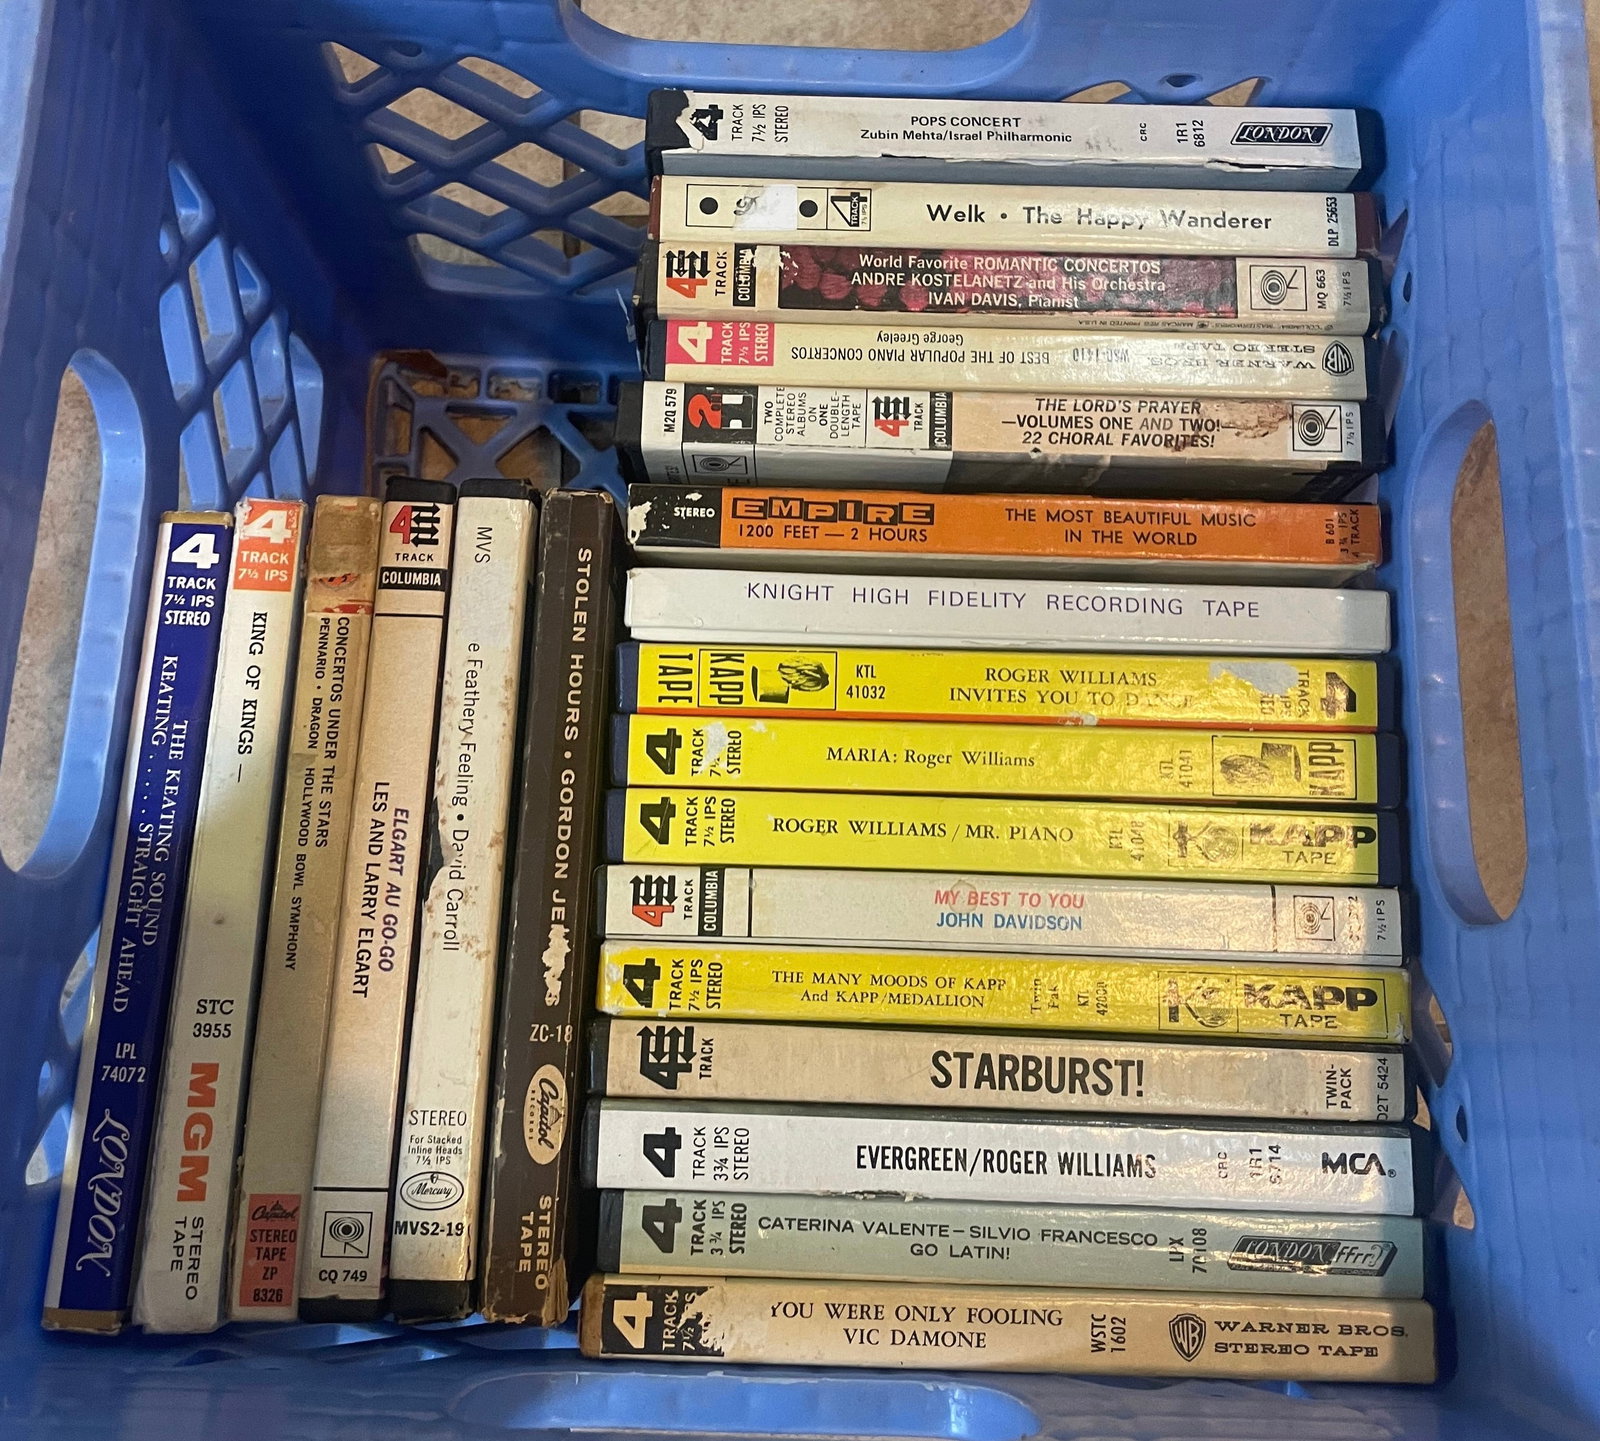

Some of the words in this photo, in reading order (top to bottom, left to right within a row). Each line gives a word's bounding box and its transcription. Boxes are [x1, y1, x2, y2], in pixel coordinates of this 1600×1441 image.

[732, 104, 743, 141] TRACK
[911, 116, 946, 126] POPS
[950, 116, 1021, 130] CONCERT
[861, 130, 898, 140] Zubin
[903, 130, 983, 141] Mehta/Israel
[987, 131, 1072, 143] Philharmonic
[928, 204, 985, 223] Welk
[1024, 206, 1062, 225] The
[1077, 208, 1147, 229] Happy
[1160, 209, 1271, 229] Wanderer
[860, 254, 902, 268] World
[909, 256, 968, 270] Favorite
[973, 257, 1058, 272] ROMANTIC
[1064, 258, 1160, 274] CONCERTOS
[851, 273, 905, 286] ANDRE
[911, 274, 1024, 290] KOSTELANETZ
[1062, 278, 1086, 290] His
[1092, 279, 1165, 292] Orchestra
[929, 293, 965, 305] IVAN
[1029, 296, 1078, 308] Pianist
[876, 331, 919, 344] Greeley
[923, 334, 964, 346] George
[791, 346, 862, 361] CONCERTOS
[868, 348, 905, 362] PIANO
[911, 349, 965, 363] POPULAR
[1020, 351, 1050, 365] BEST
[764, 401, 773, 424] TWO
[775, 387, 785, 442] COMPLETE
[797, 391, 806, 437] ALBUMS
[841, 394, 850, 437] LENGTH
[1036, 398, 1067, 412] THE
[1073, 398, 1131, 413] LORD'S
[1137, 400, 1201, 415] PRAYER
[1099, 416, 1133, 430] ONE
[1139, 417, 1173, 430] AND
[1022, 432, 1042, 444] 22
[1048, 432, 1115, 445] CHORAL
[1121, 433, 1215, 448] FAVORITES!
[732, 497, 934, 525] EMPIRE
[1005, 508, 1036, 522] THE
[1047, 509, 1093, 523] MOST
[1104, 511, 1191, 526] BEAUTIFUL
[1201, 513, 1257, 527] MUSIC
[474, 526, 492, 564] MVS
[739, 525, 773, 538] 1200
[784, 525, 819, 539] FEET
[869, 528, 928, 542] HOURS
[1093, 530, 1123, 544] THE
[1133, 531, 1197, 546] WORLD
[172, 533, 219, 568] 4
[241, 551, 289, 565] TRACK
[168, 576, 216, 590] TRACK
[382, 571, 441, 586] COLUMBIA
[572, 547, 592, 643] STOLEN
[747, 582, 834, 601] KNIGHT
[853, 587, 908, 605] HIGH
[928, 590, 1026, 610] FIDELITY
[1047, 594, 1183, 615] RECORDING
[1203, 599, 1260, 618] TAPE
[165, 610, 210, 626] STEREO
[248, 612, 268, 656] KING
[314, 617, 330, 680] PENNARIO
[328, 617, 350, 702] CONCERTOS
[856, 664, 877, 679] KTL
[986, 668, 1050, 684] ROGER
[1060, 669, 1157, 687] WILLIAMS
[458, 659, 483, 736] Feathery
[564, 654, 584, 741] HOURS
[846, 686, 886, 700] 41032
[949, 687, 1027, 704] INVITES
[237, 698, 258, 755] KINGS
[308, 698, 322, 749] DRAGON
[323, 708, 341, 760] UNDER
[827, 747, 898, 763] MARIA:
[904, 750, 952, 768] Roger
[961, 750, 1034, 767] Williams
[452, 742, 476, 807] Feeling
[297, 767, 315, 847] HOLLYWOOD
[372, 781, 390, 812] LES
[154, 769, 181, 862] KEATING
[315, 801, 332, 848] STARS
[554, 768, 576, 880] GORDON
[368, 819, 385, 856] AND
[388, 807, 409, 876] ELGART
[849, 820, 947, 838] WILLIAMS
[1009, 827, 1073, 842] PIANO
[1250, 823, 1376, 848] KAPP
[1282, 850, 1336, 865] TAPE
[124, 822, 153, 927] STRAIGHT
[292, 853, 306, 890] BOWL
[361, 863, 381, 921] LARRY
[703, 869, 718, 932] COLUMBIA
[967, 891, 1011, 908] BEST
[142, 871, 166, 946] SOUND
[442, 889, 464, 951] Carroll
[285, 897, 302, 971] SYMPHONY
[937, 912, 983, 928] JOHN
[994, 914, 1082, 931] DAVIDSON
[378, 913, 398, 972] GO-GO
[113, 937, 135, 1013] AHEAD
[353, 927, 374, 998] ELGART
[772, 971, 803, 983] THE
[812, 973, 863, 985] MANY
[870, 974, 928, 989] MOODS
[196, 999, 234, 1015] STC
[801, 990, 829, 1002] And
[193, 1023, 232, 1038] 3955
[1280, 1013, 1337, 1029] TAPE
[115, 1043, 137, 1060] LPL
[101, 1065, 146, 1083] 74072
[930, 1050, 1145, 1097] STARBURST!
[1377, 1057, 1389, 1089] 5424
[1341, 1067, 1352, 1109] PACK
[409, 1110, 467, 1126] STEREO
[538, 1078, 559, 1150] Capitol
[177, 1062, 220, 1202] MGM
[427, 1135, 462, 1145] Stacked
[436, 1146, 463, 1155] Heads
[643, 1127, 681, 1177] 4
[693, 1126, 706, 1179] TRACK
[734, 1127, 750, 1181] STEREO
[76, 1108, 131, 1277] LONDON
[411, 1182, 453, 1198] Mercury
[250, 1229, 297, 1243] STEREO
[729, 1202, 747, 1254] STEREO
[758, 1216, 855, 1233] CATERINA
[1040, 1229, 1158, 1246] FRANCESCO
[256, 1247, 286, 1262] TAPE
[910, 1244, 938, 1257] GO
[949, 1244, 1010, 1261] LATIN!
[343, 1270, 367, 1282] 749
[253, 1288, 283, 1302] 8326
[770, 1302, 814, 1318] YOU
[824, 1303, 885, 1320] WERE
[895, 1305, 956, 1322] ONLY
[967, 1307, 1063, 1327] FOOLING
[844, 1328, 880, 1345] VIC
[890, 1330, 987, 1348] DAMONE
[1091, 1313, 1106, 1353] WSTC
[1110, 1316, 1126, 1353] 1602
[1214, 1320, 1330, 1335] WARNER
[1338, 1323, 1409, 1338] BROS.
[1214, 1342, 1310, 1355] STEREO
[1318, 1344, 1379, 1357] TAPE
